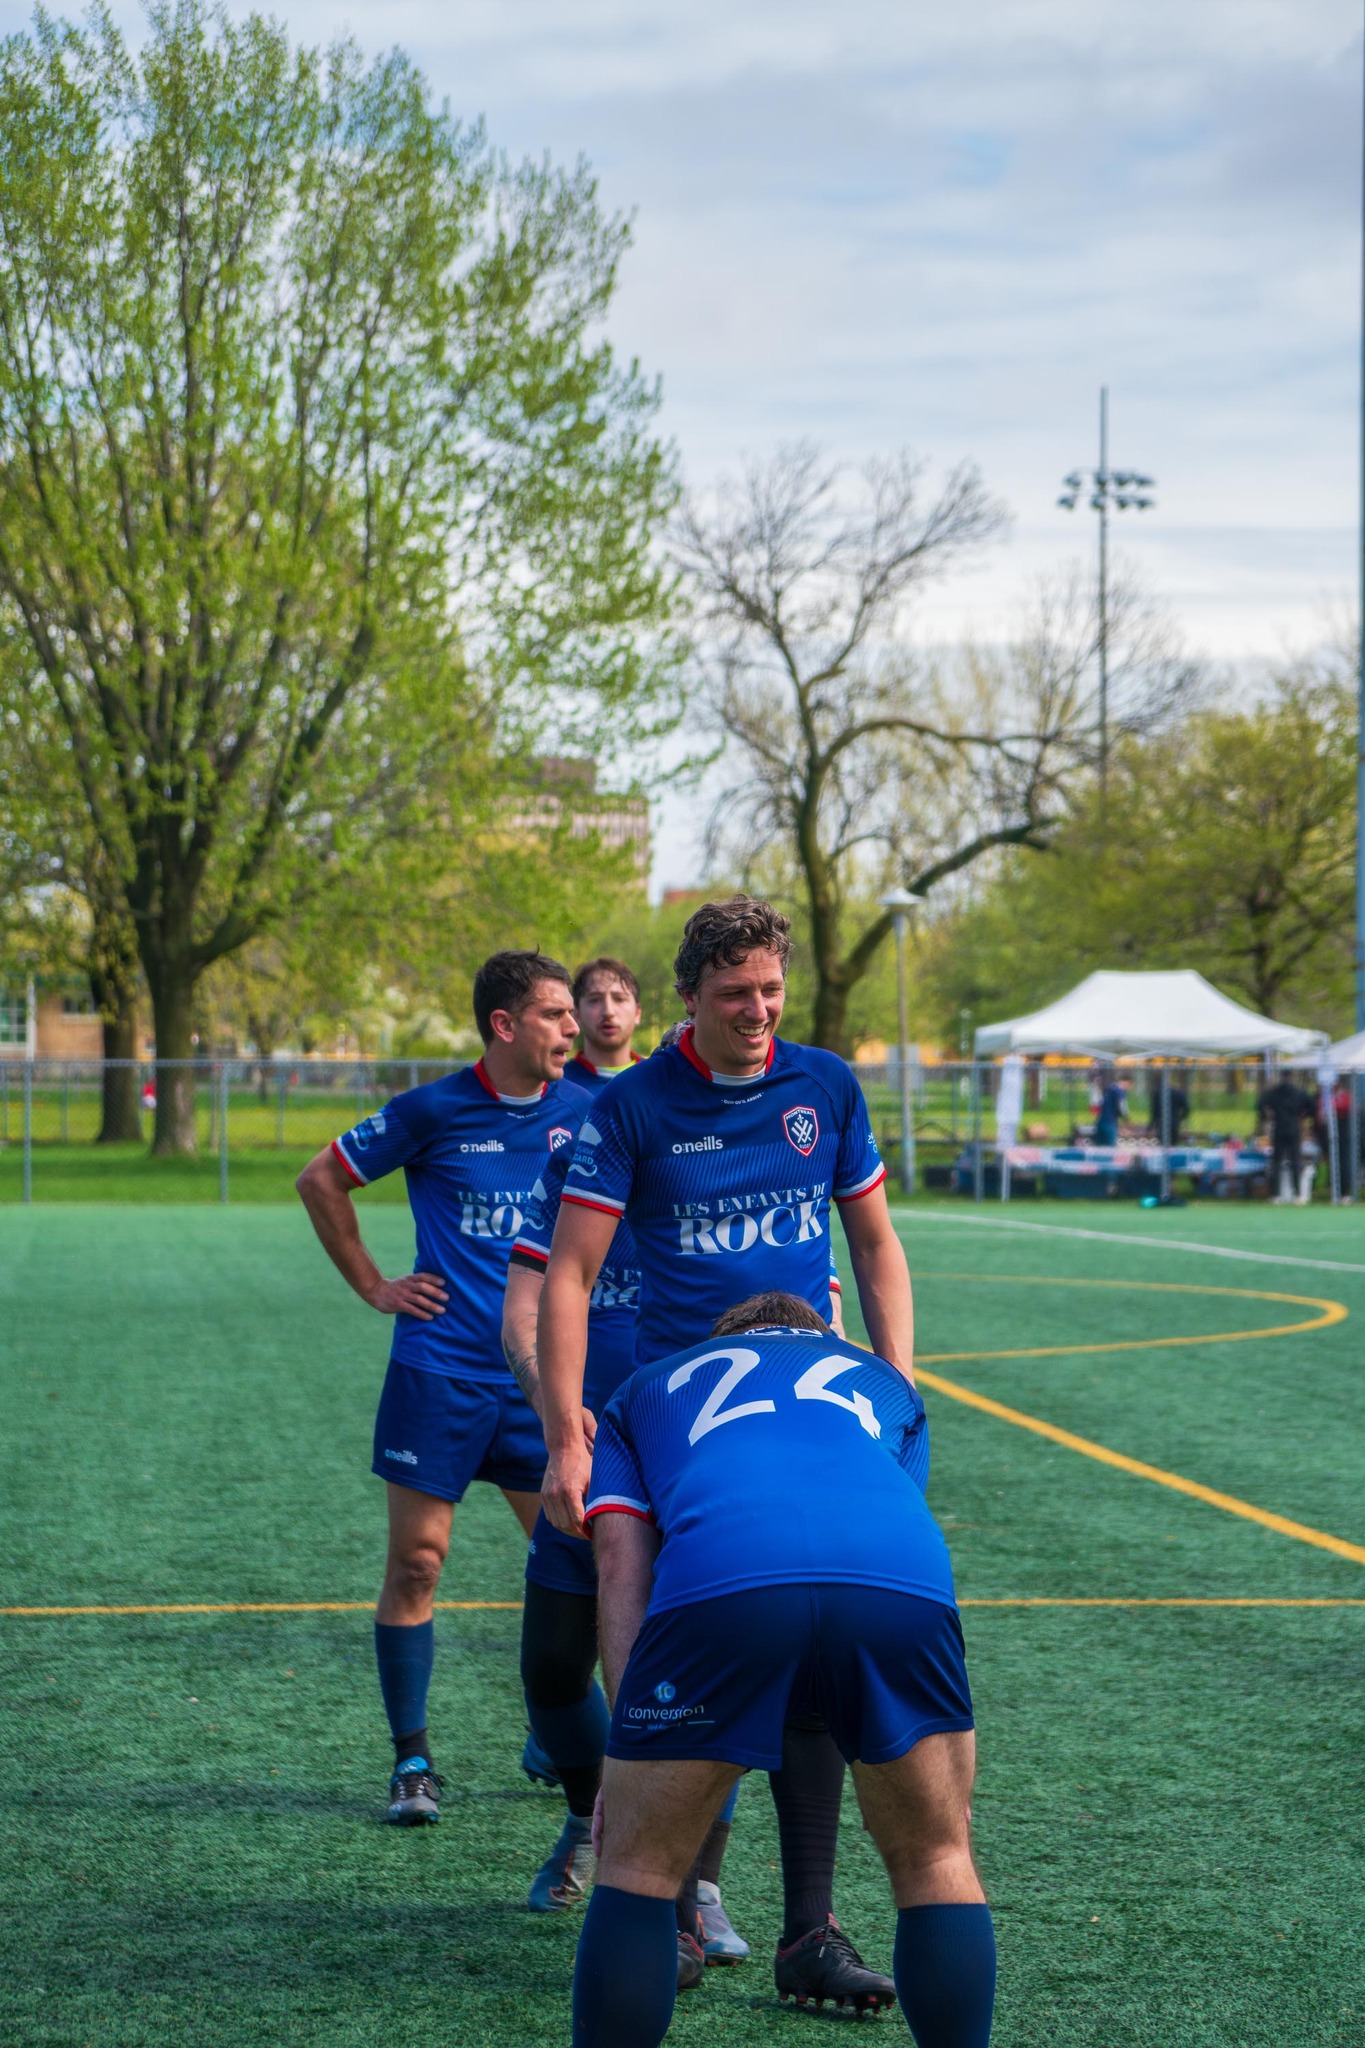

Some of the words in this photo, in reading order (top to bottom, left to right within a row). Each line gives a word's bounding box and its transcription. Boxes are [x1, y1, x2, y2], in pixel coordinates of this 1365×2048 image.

[673, 1201, 710, 1217] LES
[718, 1187, 807, 1213] ENFANTS
[673, 1196, 825, 1256] ROCK
[667, 1347, 882, 1447] 24
